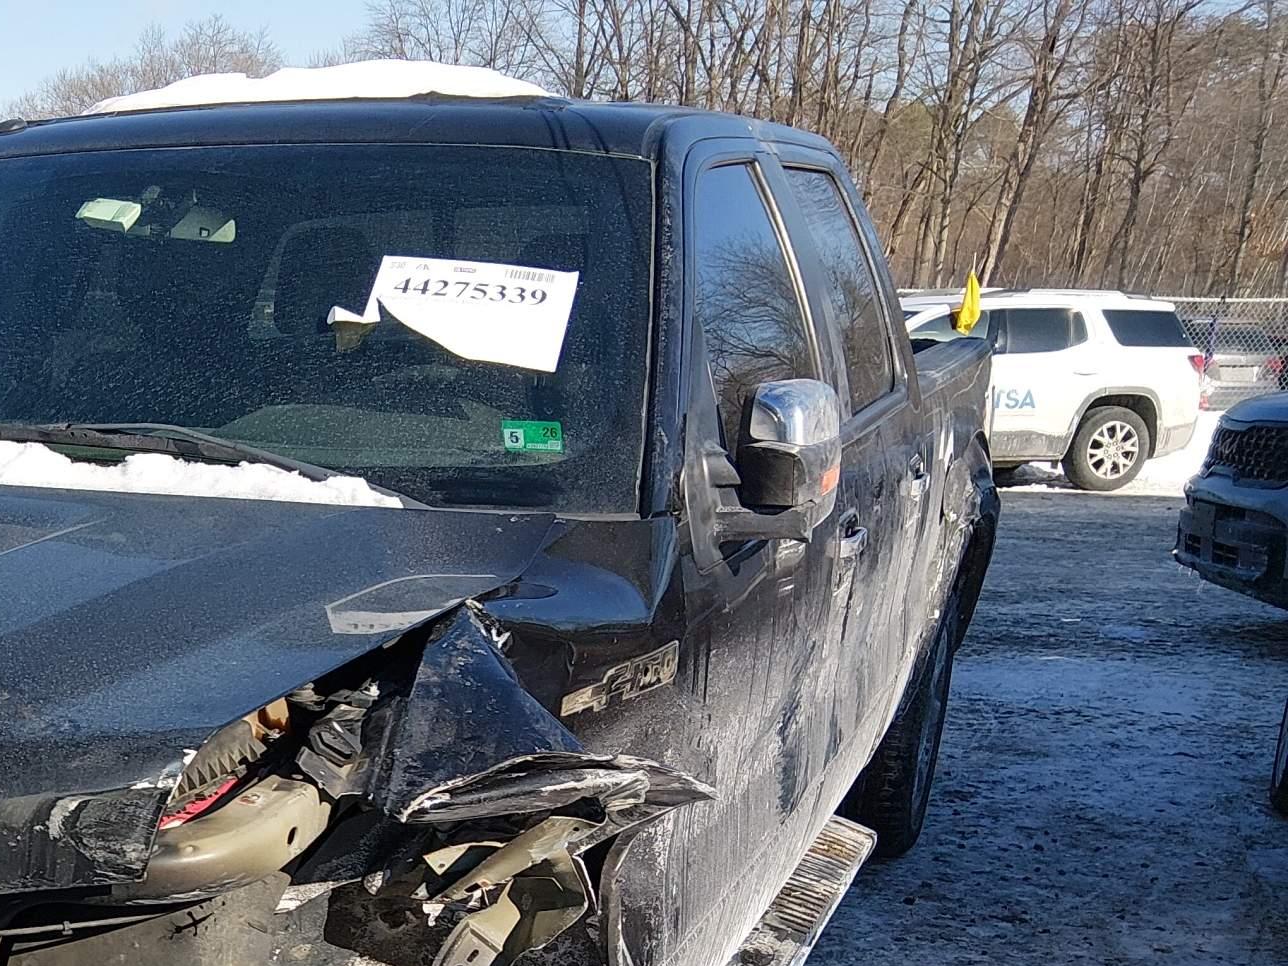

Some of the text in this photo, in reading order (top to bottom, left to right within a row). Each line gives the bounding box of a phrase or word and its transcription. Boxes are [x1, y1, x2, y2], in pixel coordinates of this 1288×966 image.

[393, 277, 548, 306] 44275339
[509, 431, 520, 444] 5
[541, 426, 558, 439] 26
